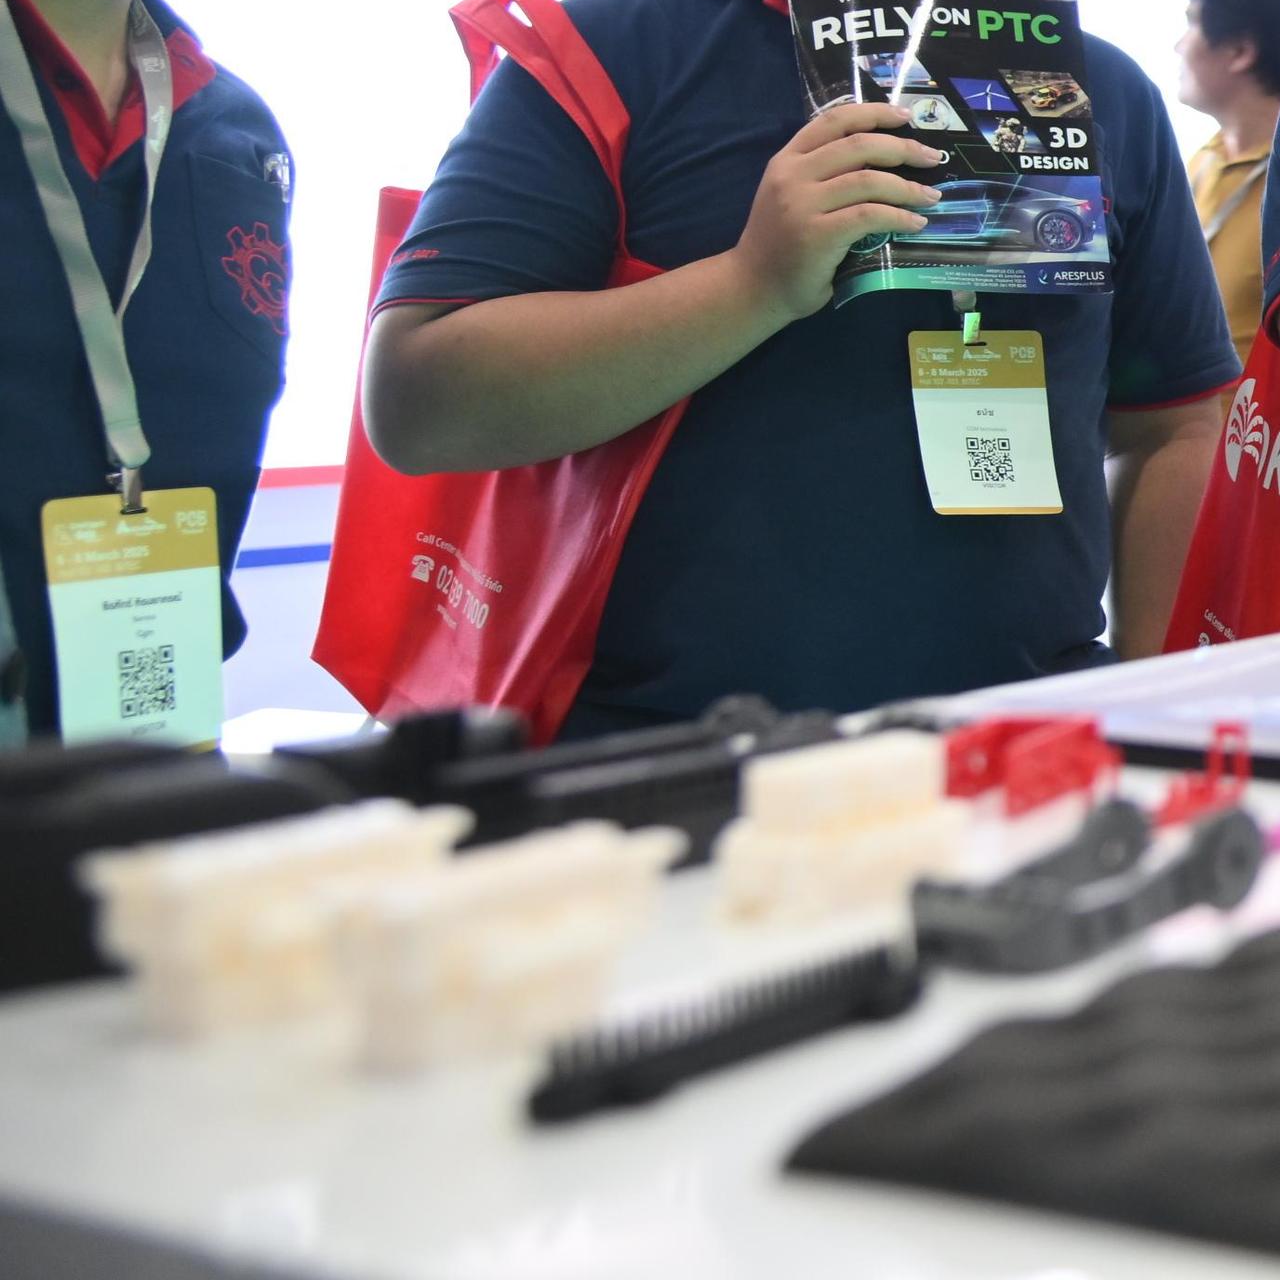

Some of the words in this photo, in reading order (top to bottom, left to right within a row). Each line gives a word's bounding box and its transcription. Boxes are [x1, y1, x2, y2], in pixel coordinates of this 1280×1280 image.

[812, 6, 925, 51] RELY
[932, 7, 971, 26] ON
[977, 9, 1063, 45] PTC
[1049, 126, 1088, 149] 3D
[1020, 155, 1089, 170] DESIGN
[1053, 270, 1105, 282] ARESPLUS
